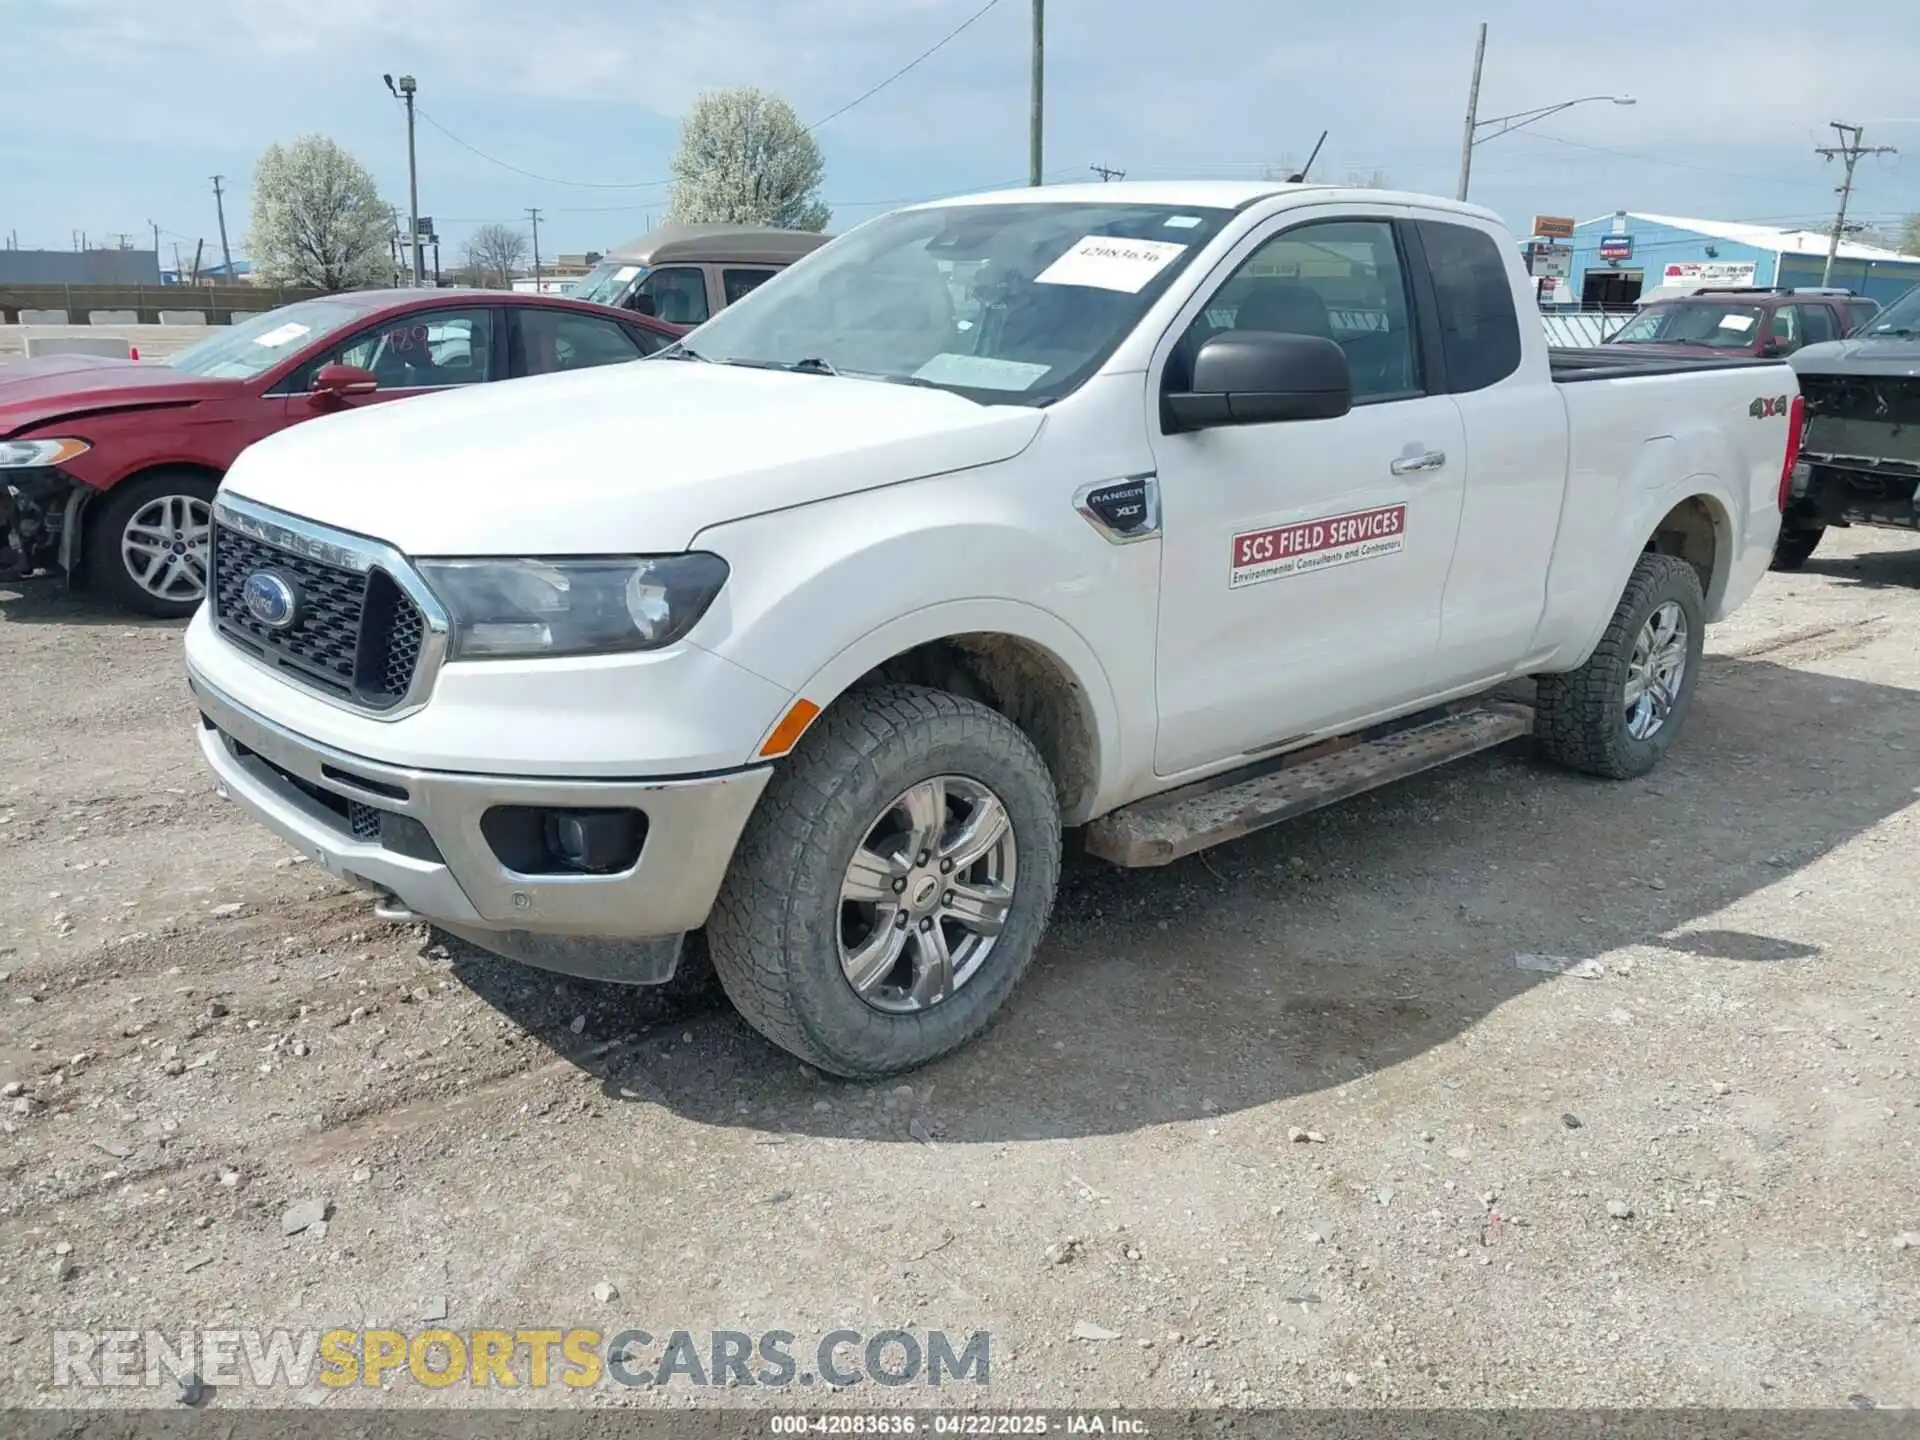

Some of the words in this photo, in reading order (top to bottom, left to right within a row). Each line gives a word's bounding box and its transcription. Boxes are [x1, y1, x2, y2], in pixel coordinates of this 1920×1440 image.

[1091, 487, 1144, 504] RANGER
[1115, 504, 1142, 519] XLT
[1241, 535, 1273, 562] SCS
[1279, 526, 1324, 555] FIELD
[1329, 511, 1399, 544] SERVICES
[1233, 560, 1294, 584] Environmental
[1296, 550, 1342, 570] Consultants
[1344, 545, 1359, 560] and
